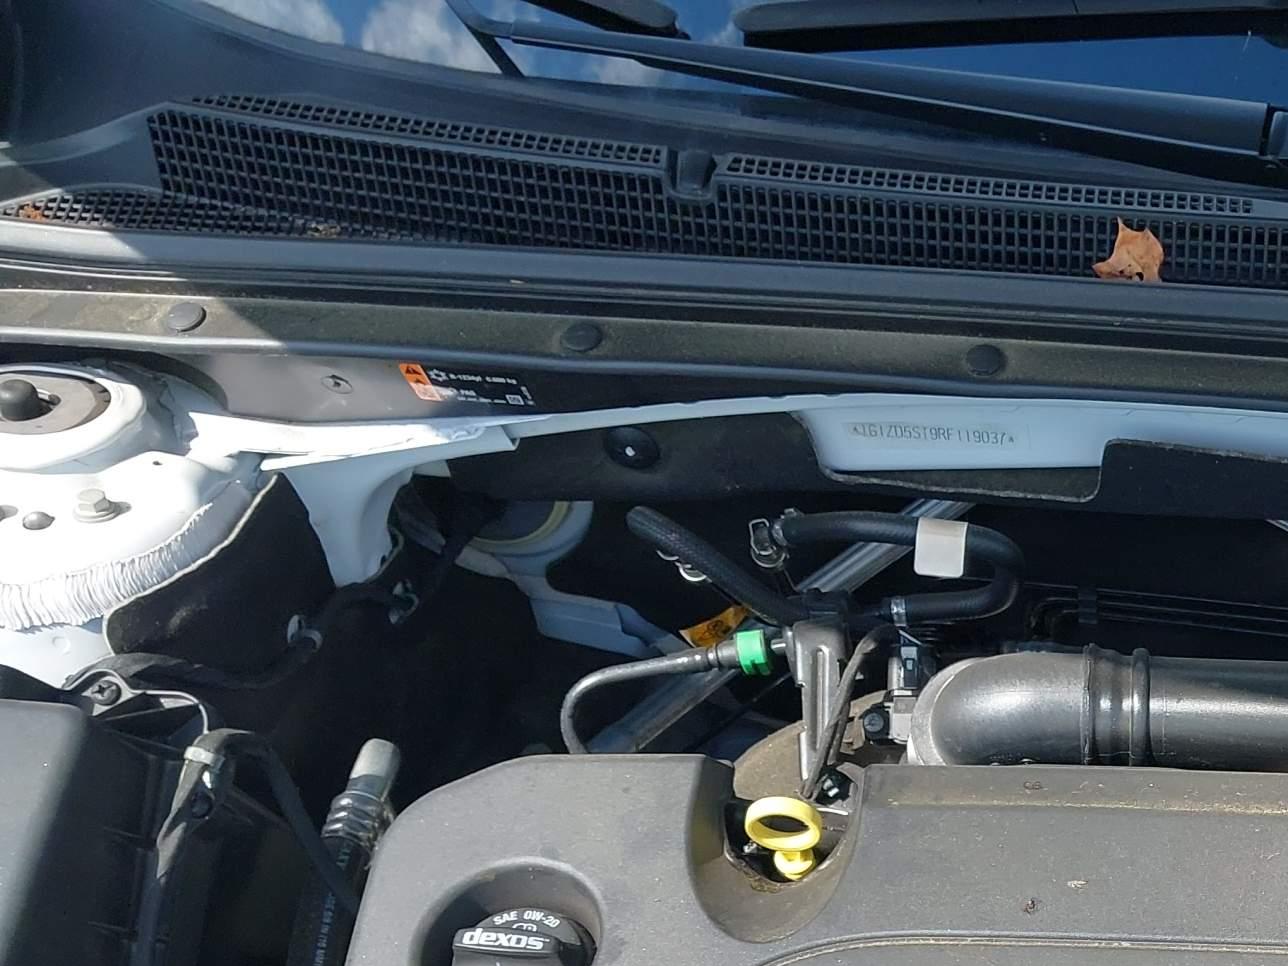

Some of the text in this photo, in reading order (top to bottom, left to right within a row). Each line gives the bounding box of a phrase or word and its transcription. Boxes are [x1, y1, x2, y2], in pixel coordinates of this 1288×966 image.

[493, 910, 560, 928] SAE 0W-20
[462, 927, 545, 950] dexos
